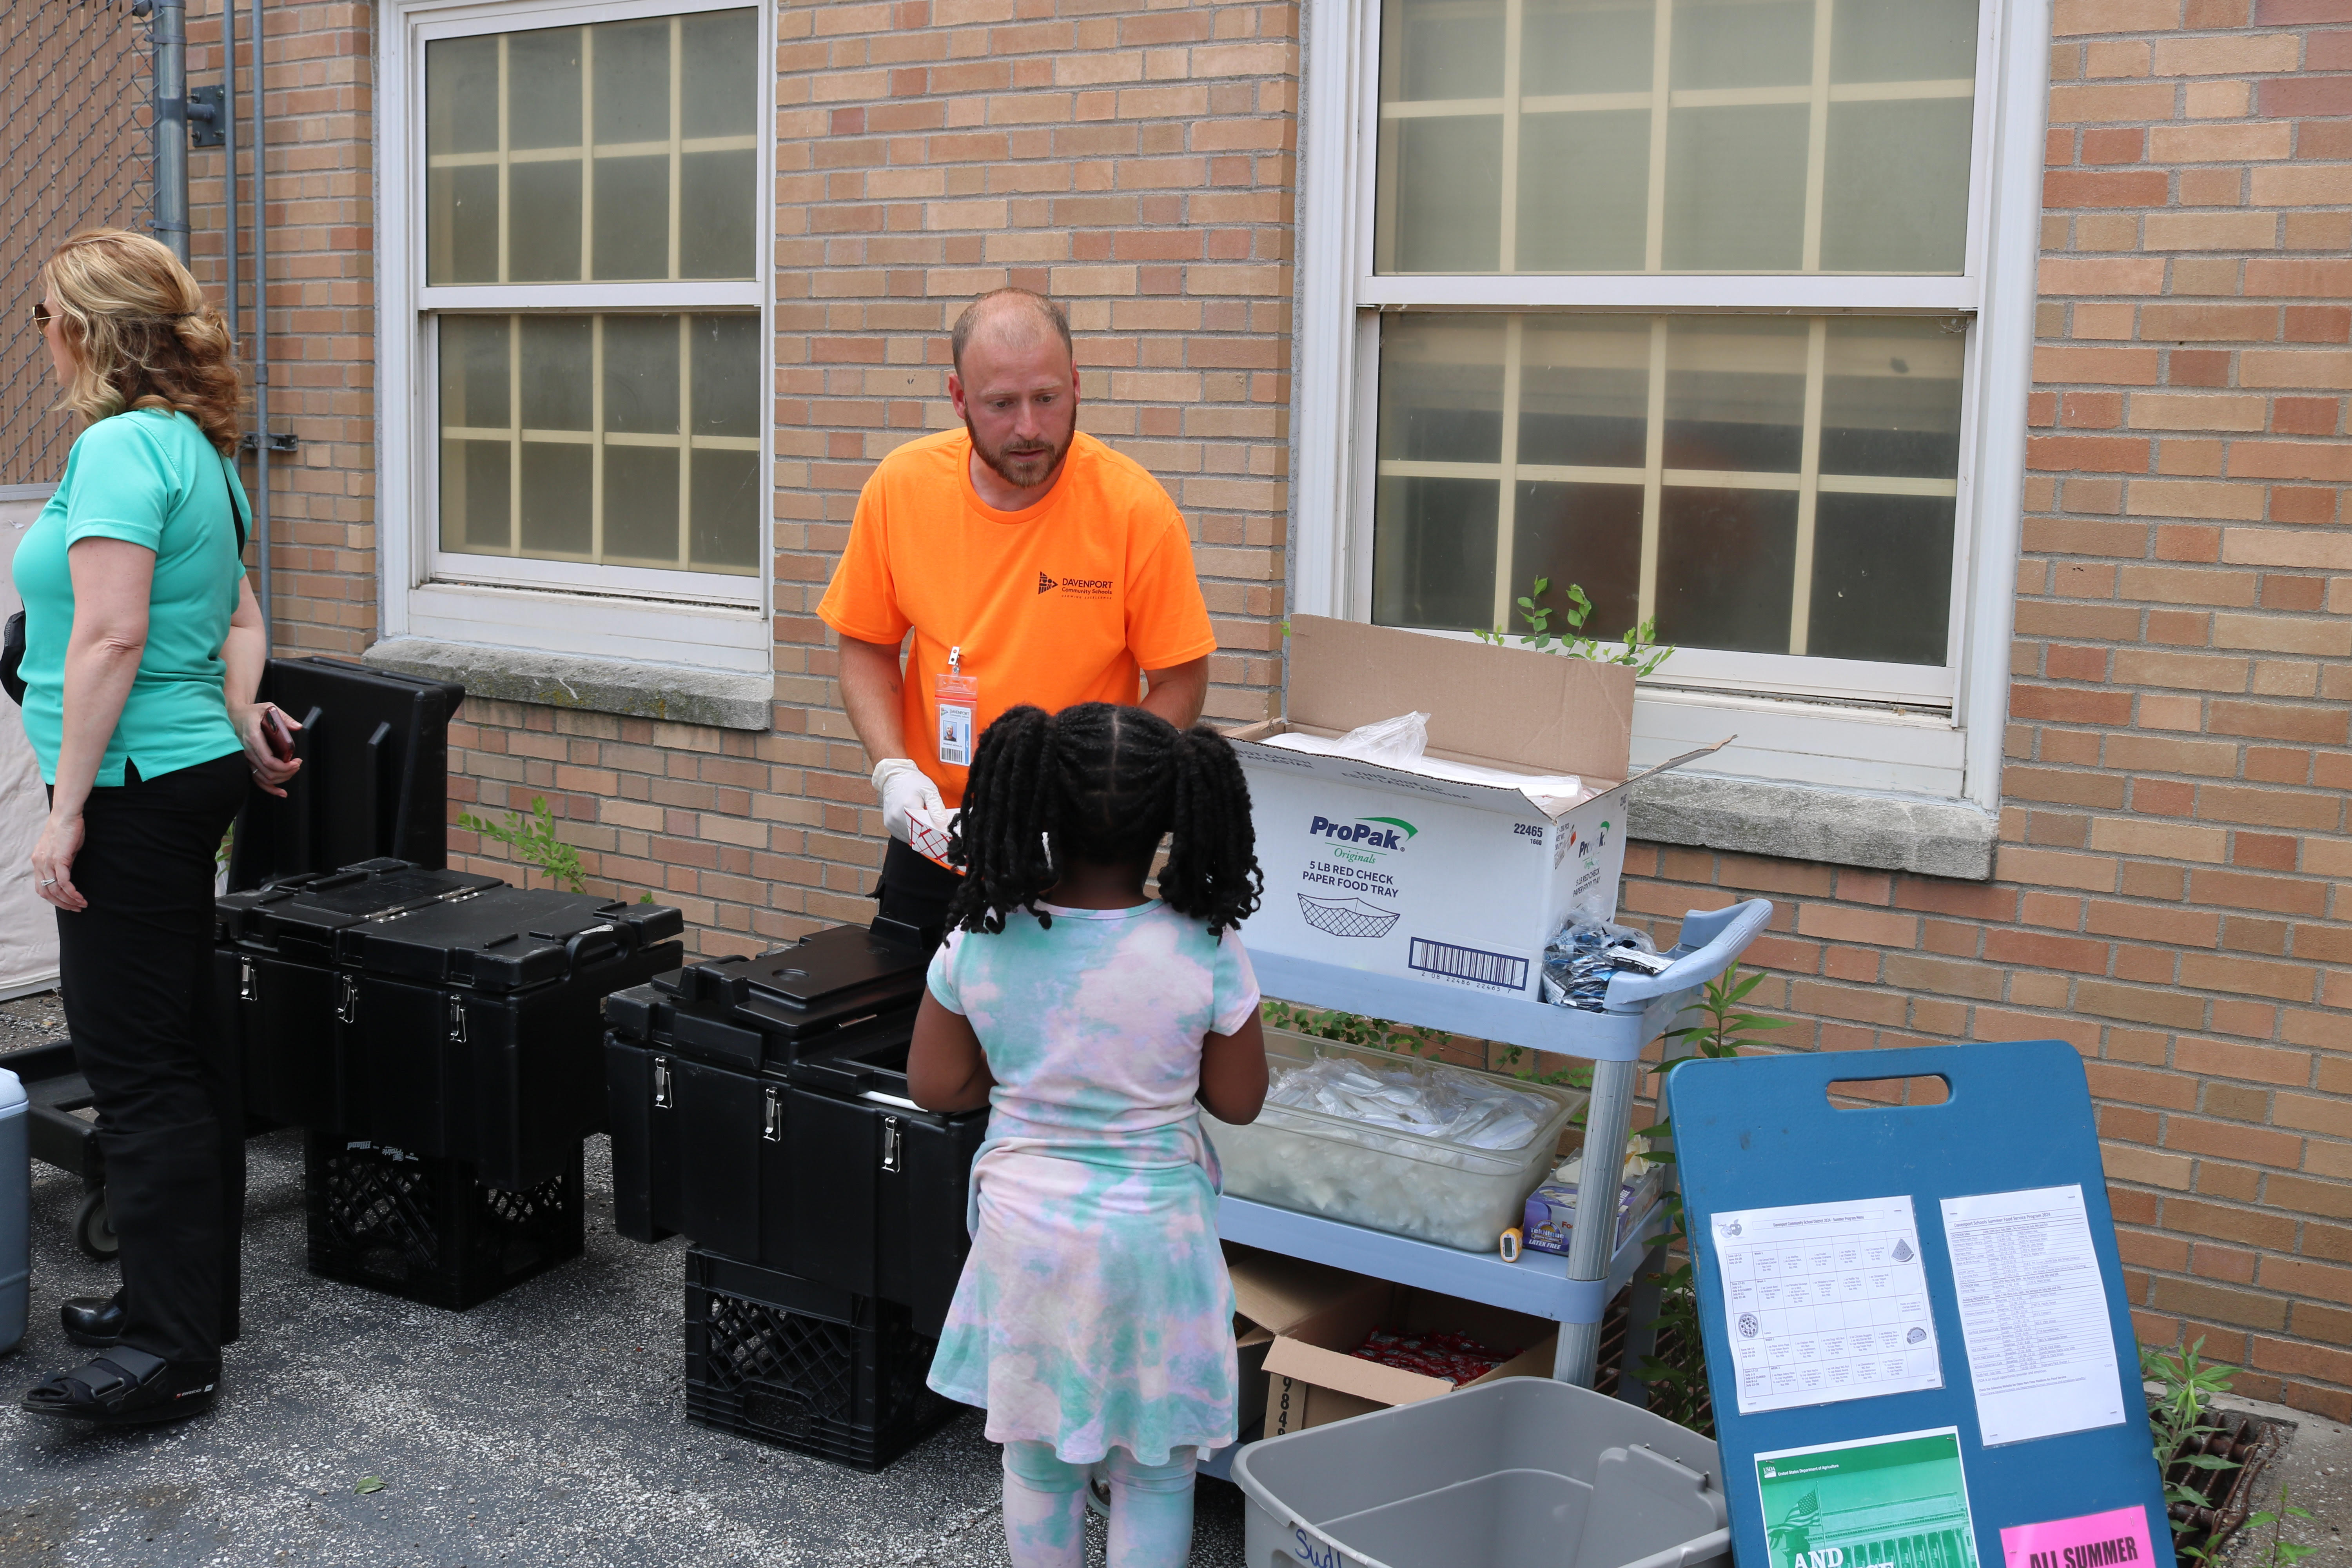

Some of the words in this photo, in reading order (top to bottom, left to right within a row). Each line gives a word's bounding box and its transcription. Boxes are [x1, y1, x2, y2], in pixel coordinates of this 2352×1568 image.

[1062, 578, 1113, 588] DAVENPORT
[1353, 771, 1387, 780] THIS
[1390, 777, 1423, 786] SIDE
[1341, 772, 1376, 782] ESTE
[1378, 779, 1416, 789] LADO
[1420, 786, 1472, 800] ARRIBA
[1310, 816, 1401, 850] ProPak
[1514, 823, 1543, 837] 22465
[1334, 848, 1376, 864] Originals
[1309, 860, 1316, 869] 5
[1318, 862, 1330, 873] LB
[1333, 865, 1354, 877] RED
[1356, 870, 1394, 885] CHECK
[1589, 867, 1601, 879] CHECK
[1303, 871, 1335, 886] PAPER
[1337, 878, 1368, 892] FOOD
[1370, 884, 1399, 898] TRAY
[1573, 886, 1583, 897] PAPER
[1446, 976, 1470, 986] 22486
[1476, 982, 1501, 992] 22465
[347, 1141, 372, 1150] Hiland
[382, 1147, 403, 1156] Prairie
[1530, 1227, 1565, 1239] TekNique
[1528, 1239, 1546, 1248] LATEX
[181, 1388, 202, 1396] BREG
[1793, 1547, 1844, 1568] AND
[2063, 1536, 2138, 1568] SUMMER
